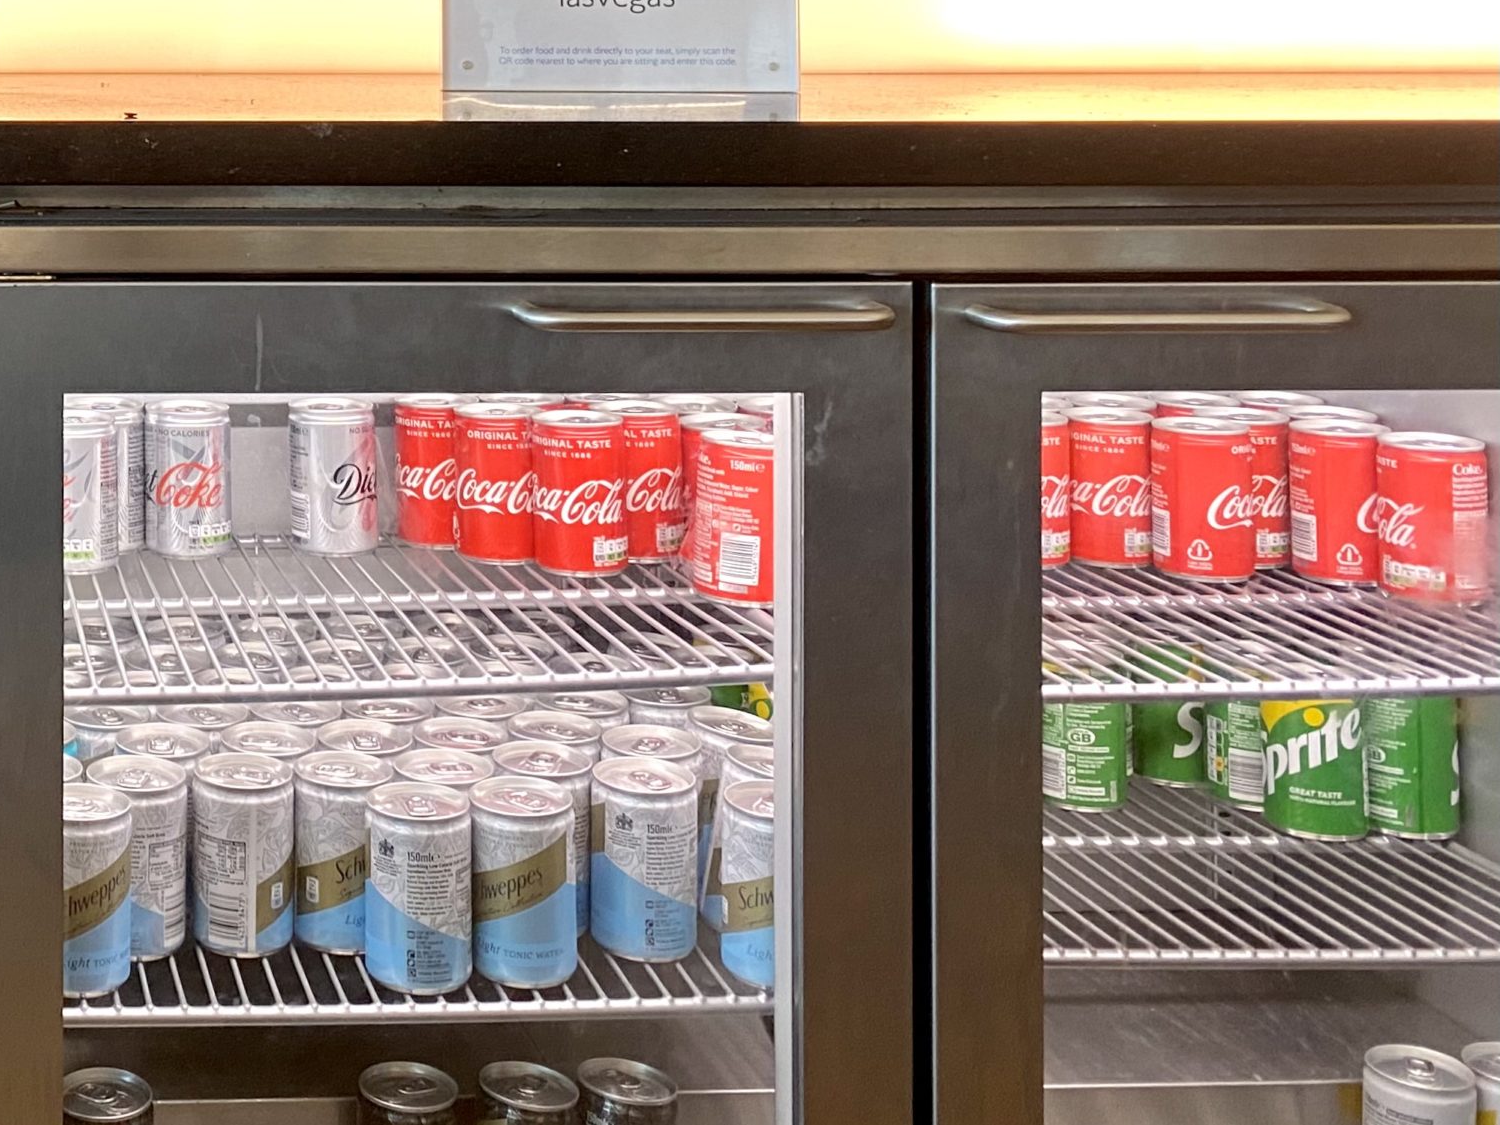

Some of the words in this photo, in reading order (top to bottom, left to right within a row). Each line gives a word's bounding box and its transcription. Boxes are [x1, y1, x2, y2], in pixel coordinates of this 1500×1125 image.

[512, 46, 533, 54] order
[535, 46, 554, 54] food
[556, 46, 570, 54] and
[572, 46, 592, 54] drink
[594, 46, 622, 56] directly
[635, 48, 653, 56] your
[703, 47, 720, 55] scan
[722, 46, 736, 55] the
[514, 57, 534, 65] code
[536, 57, 564, 65] nearest
[567, 57, 575, 65] to
[577, 57, 601, 65] where
[603, 58, 619, 67] you
[660, 57, 675, 65] and
[467, 430, 518, 440] ORIGINAL
[641, 429, 672, 438] TASTE
[577, 440, 611, 449] TASTE
[1110, 436, 1144, 445] TASTE
[544, 450, 567, 458] SINCE
[156, 461, 223, 508] Coke
[1070, 733, 1091, 743] GB
[1260, 707, 1362, 796] prite
[1289, 786, 1316, 797] GREAT
[1318, 790, 1343, 799] TASTE
